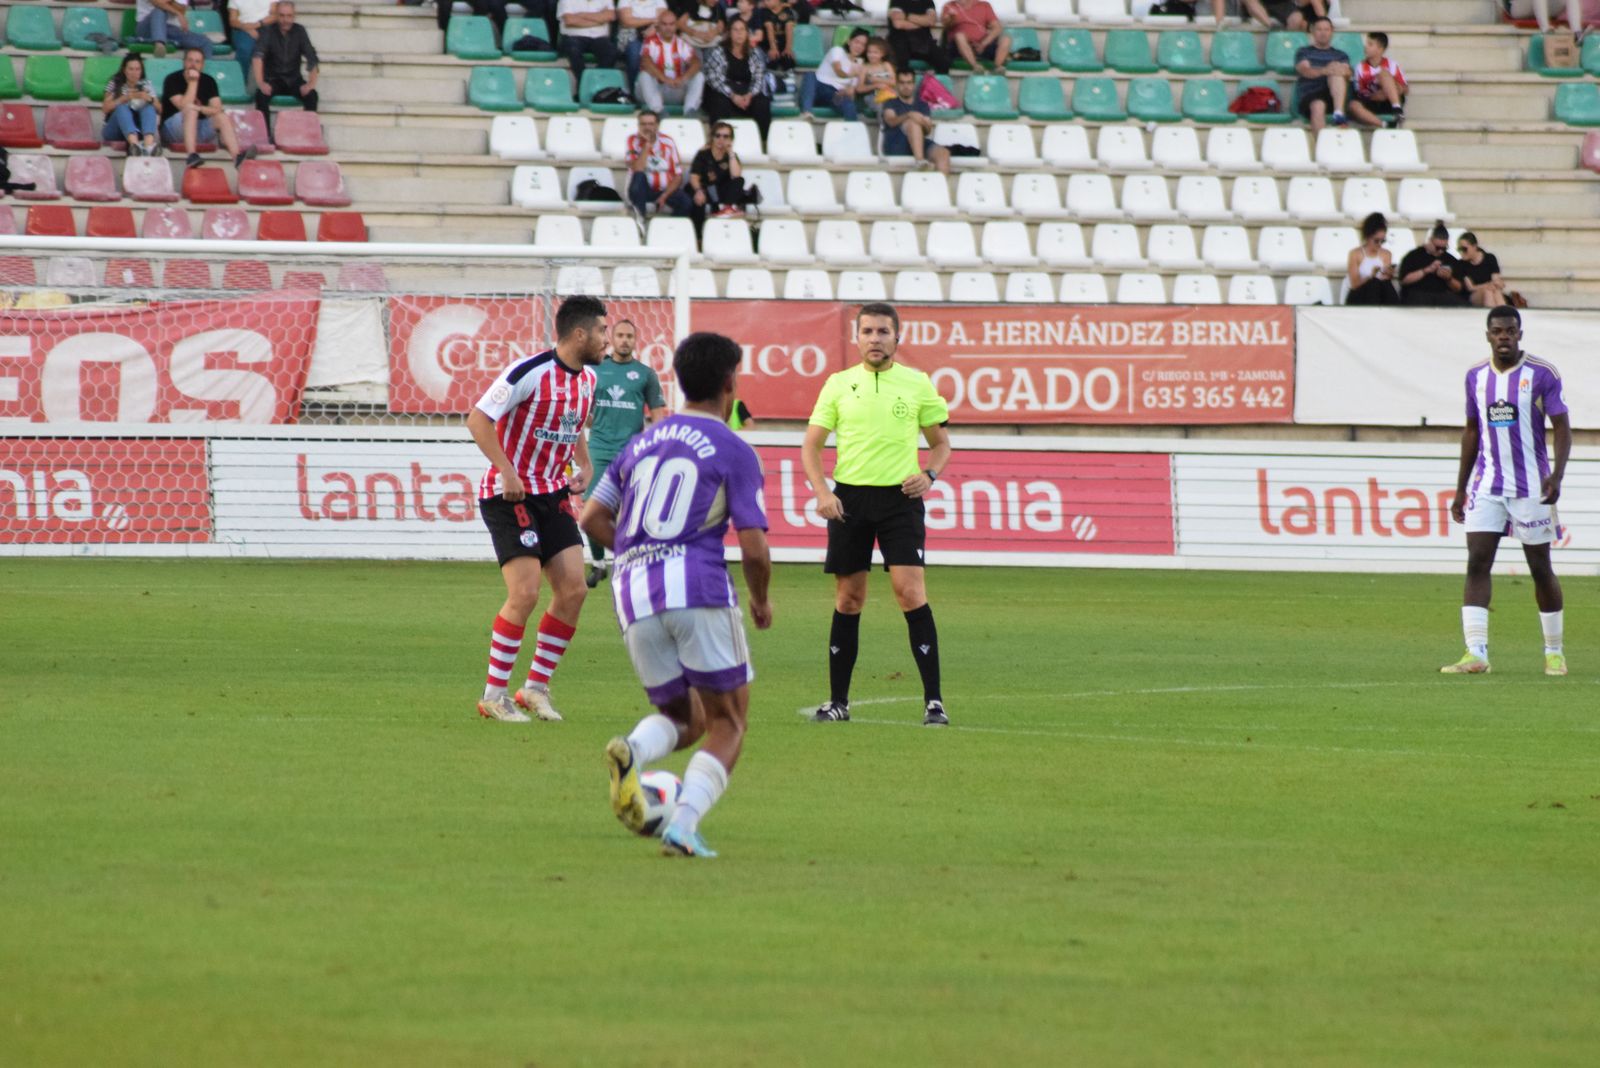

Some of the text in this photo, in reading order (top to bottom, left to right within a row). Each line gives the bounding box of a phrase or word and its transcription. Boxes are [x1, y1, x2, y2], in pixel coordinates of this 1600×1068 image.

[947, 321, 976, 346] A.
[982, 315, 1164, 346] HERNÁNDEZ
[1173, 321, 1287, 346] BERNAL
[931, 367, 1120, 412] OGADO
[1237, 370, 1286, 381] ZAMORA
[1143, 385, 1285, 408] 635 365 442
[535, 429, 559, 441] CAJA
[297, 454, 476, 522] lanta
[626, 456, 698, 540] 10
[780, 459, 1063, 532] laania
[514, 504, 530, 527] 8
